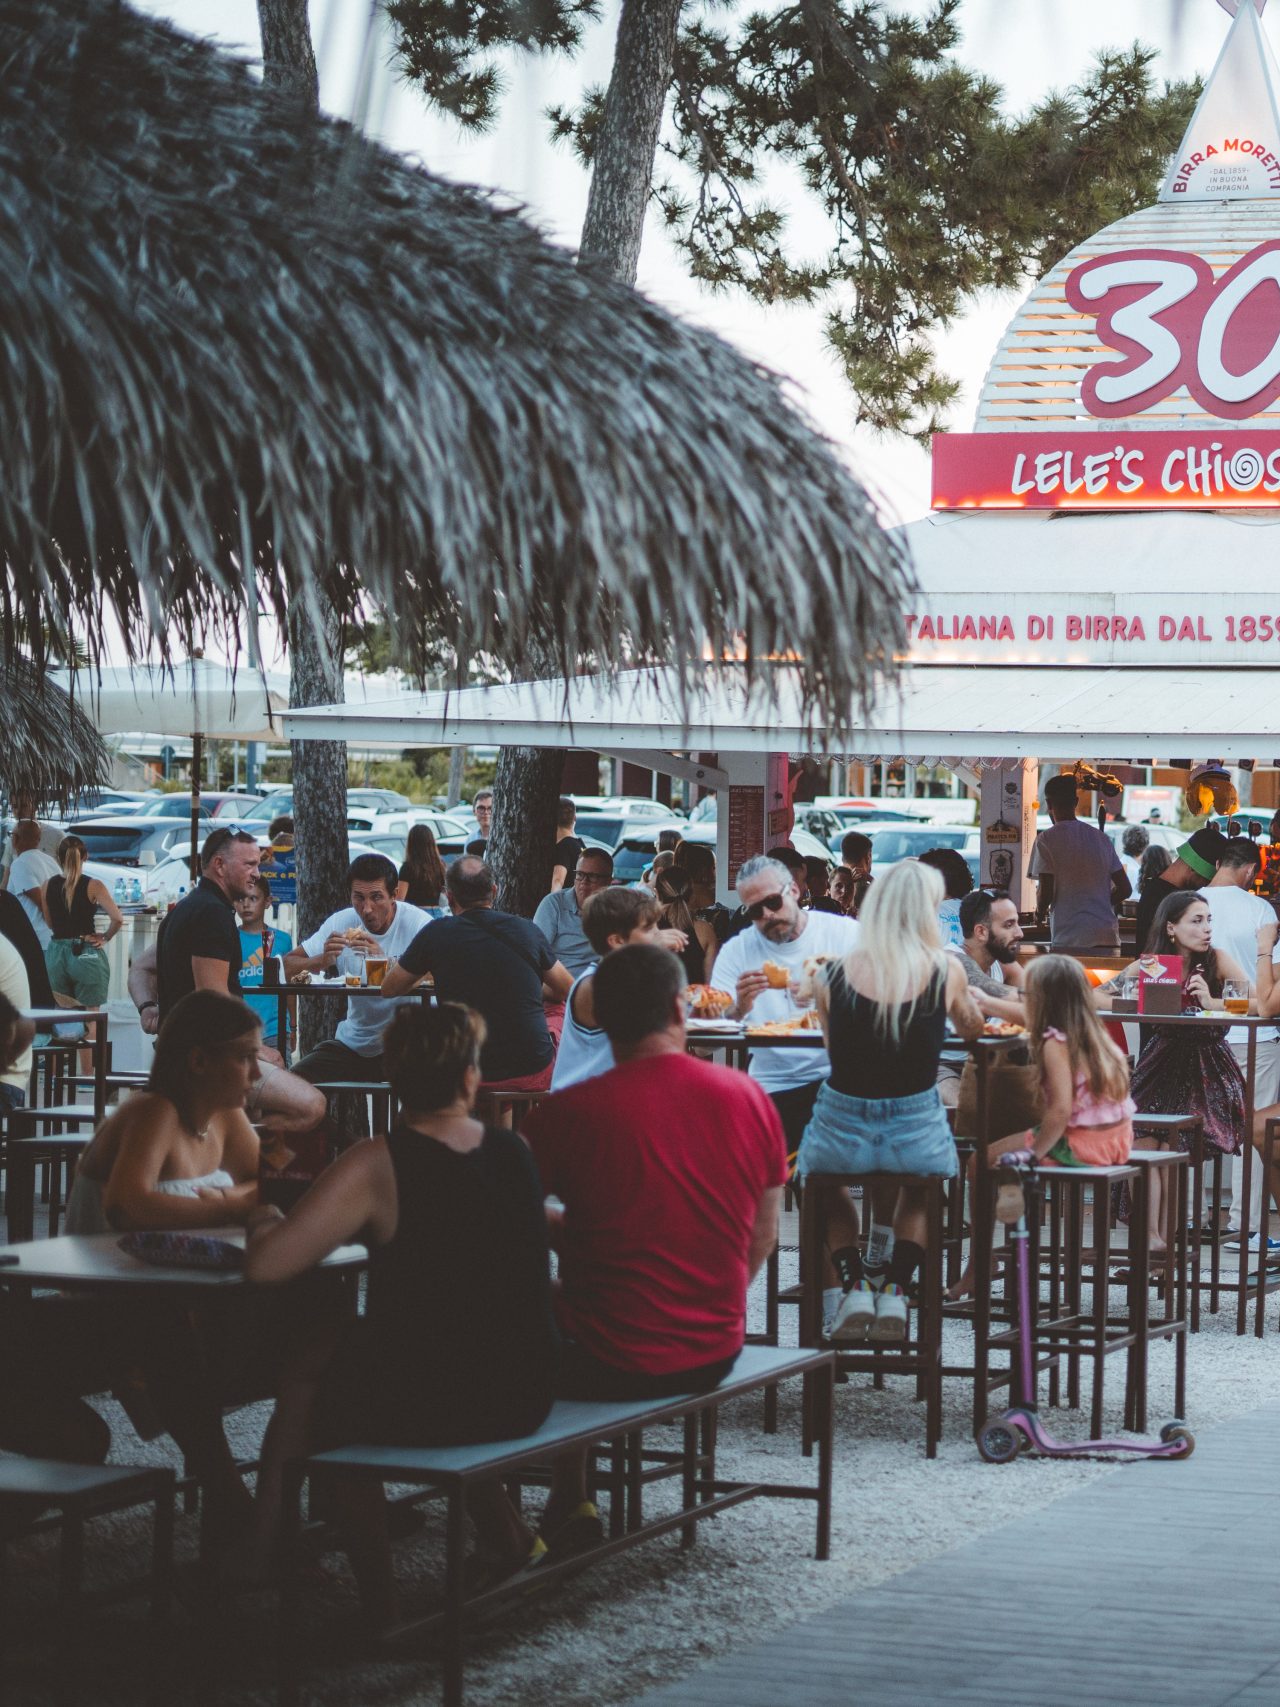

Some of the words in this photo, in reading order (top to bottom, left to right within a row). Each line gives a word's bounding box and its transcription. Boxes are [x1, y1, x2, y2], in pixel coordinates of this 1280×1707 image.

[1172, 144, 1219, 193] BIRRA
[1205, 184, 1250, 192] COMPAGNIA
[1011, 445, 1145, 496] LELE'S
[902, 614, 1015, 641] TALIANA
[1027, 614, 1054, 641] DI
[1065, 614, 1146, 642] BIRRA
[1158, 614, 1213, 642] DAL
